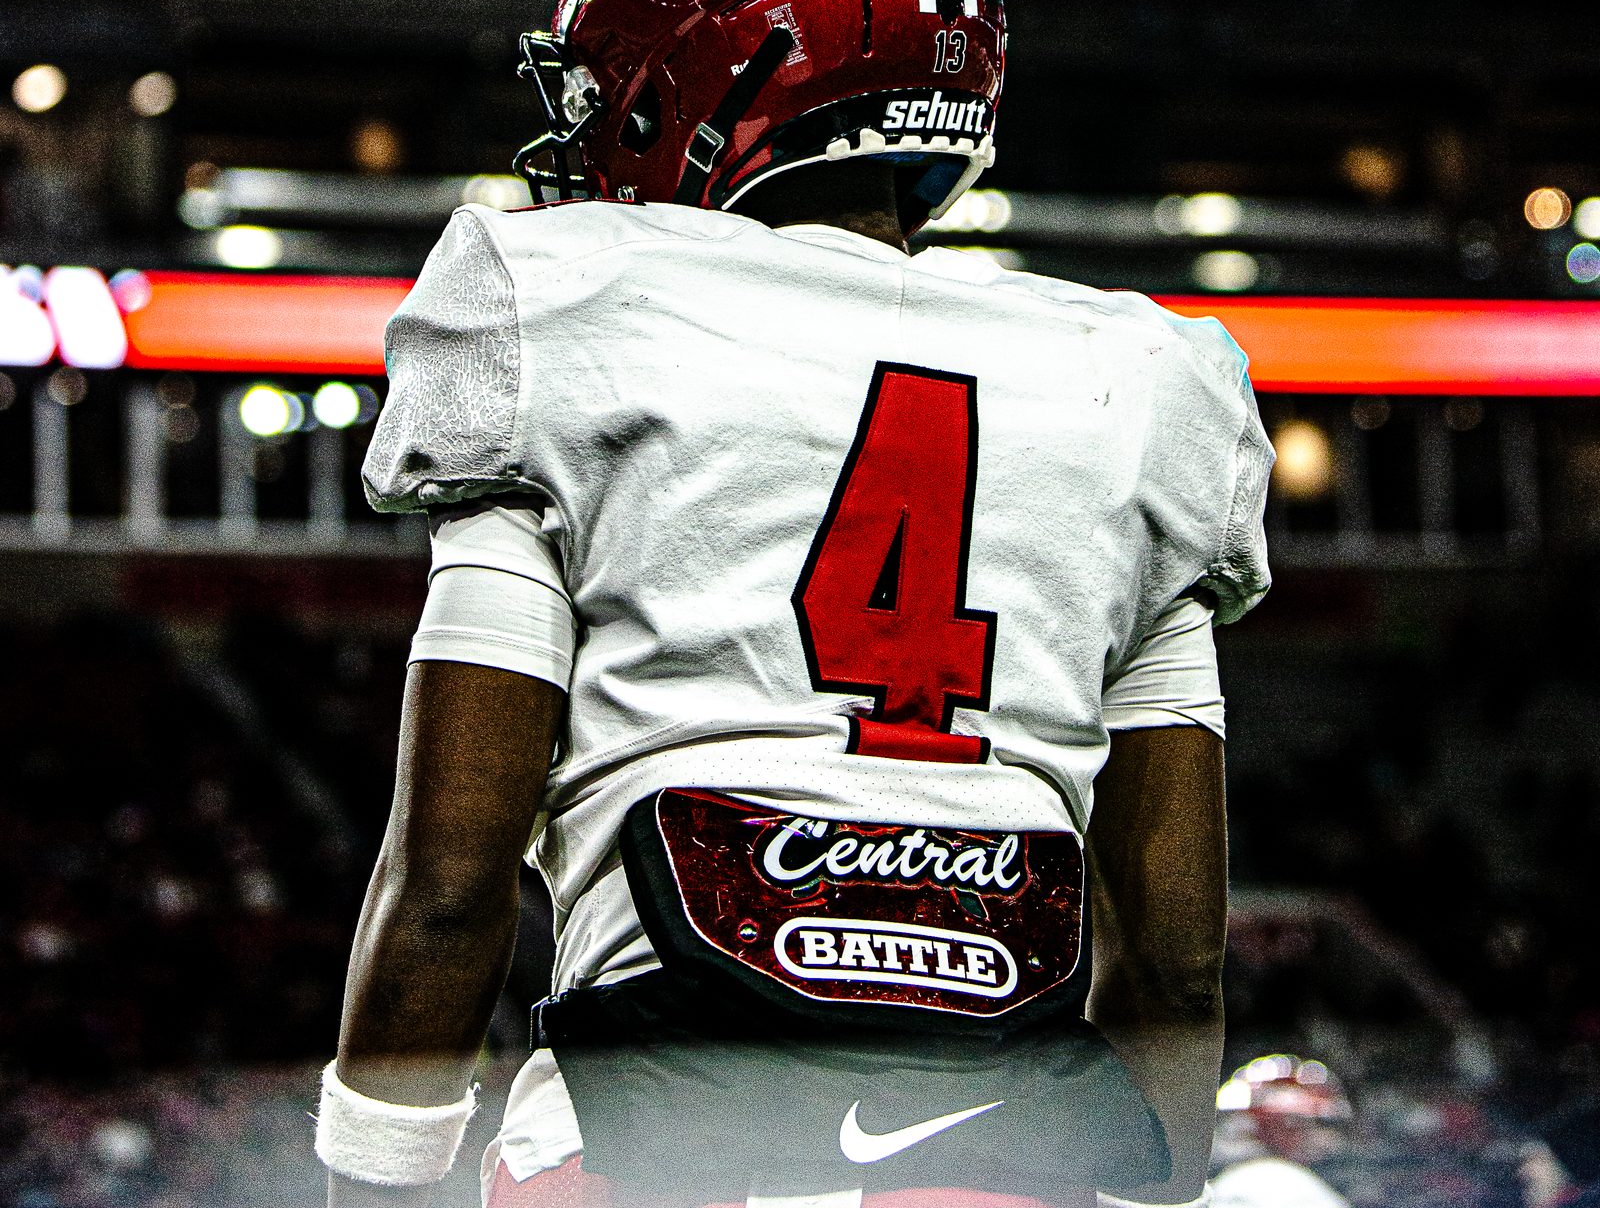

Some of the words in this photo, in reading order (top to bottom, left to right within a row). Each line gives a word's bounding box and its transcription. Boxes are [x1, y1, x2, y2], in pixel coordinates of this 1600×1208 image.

[764, 2, 792, 16] RECERTIFIED
[933, 30, 967, 73] 13
[882, 91, 987, 134] schutt
[791, 360, 998, 764] 4
[763, 817, 1021, 889] Central
[799, 930, 997, 985] BATTLE
